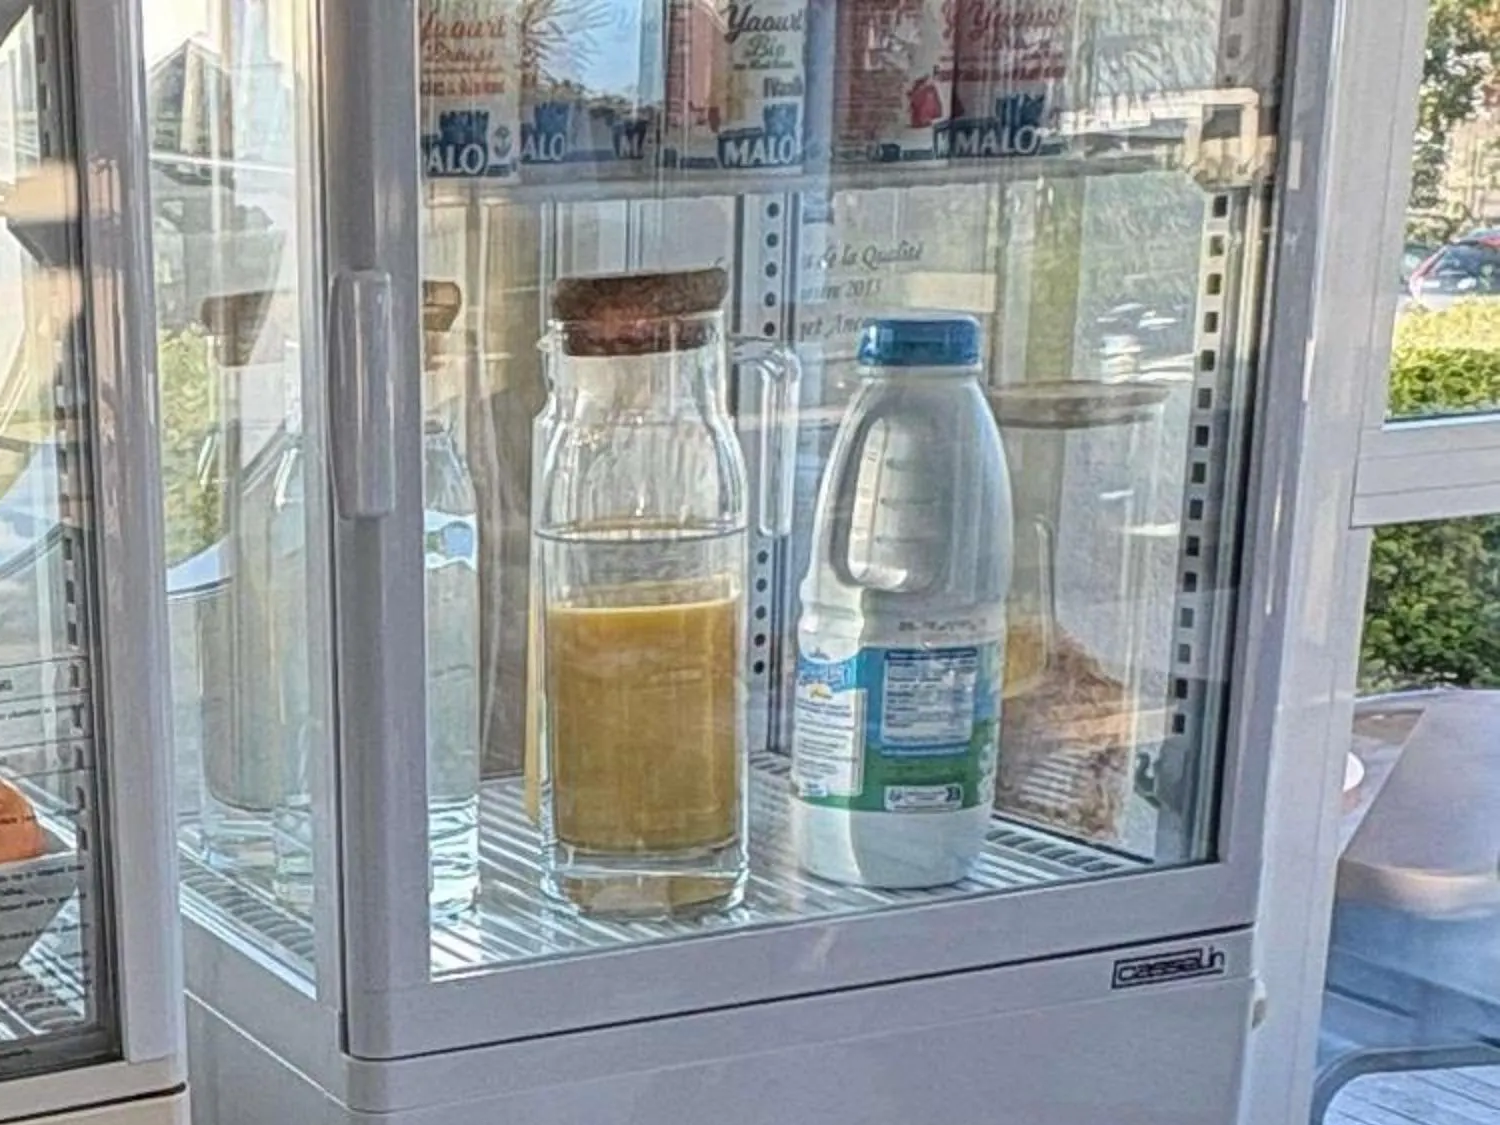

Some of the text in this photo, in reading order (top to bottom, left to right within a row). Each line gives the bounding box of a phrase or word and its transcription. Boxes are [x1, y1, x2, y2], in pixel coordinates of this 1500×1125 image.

[722, 134, 797, 167] MALO
[956, 124, 1040, 156] MALO
[424, 143, 486, 176] ALO
